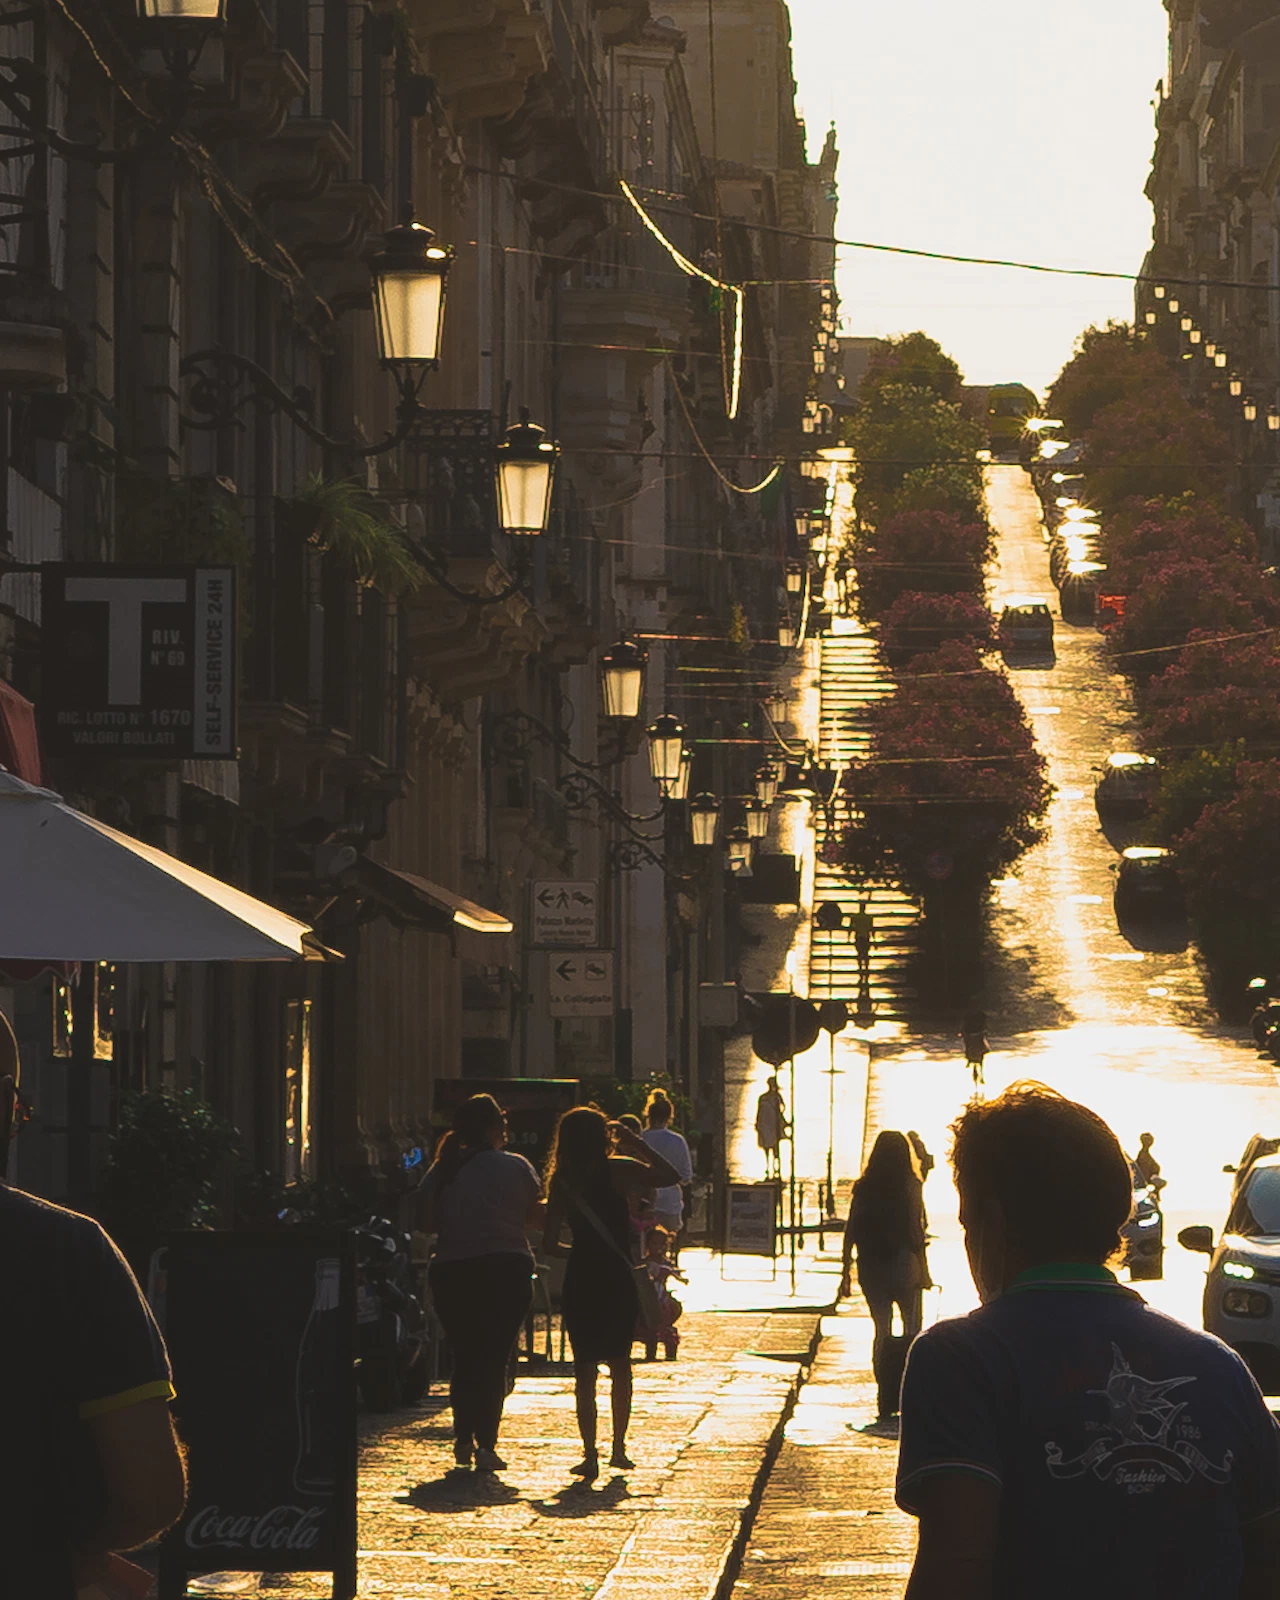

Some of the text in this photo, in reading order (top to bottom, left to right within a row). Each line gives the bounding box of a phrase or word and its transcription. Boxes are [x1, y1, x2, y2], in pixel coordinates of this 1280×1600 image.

[64, 577, 187, 706] T
[151, 629, 185, 646] RIV.
[150, 650, 186, 667] N° 69
[205, 578, 224, 747] SELF-SERVICE 24H
[57, 712, 83, 726] RIC.
[86, 712, 126, 725] LOTTO
[150, 709, 193, 727] 1670
[72, 731, 177, 746] VALORI BOLLATI
[1176, 1424, 1202, 1440] 1986
[184, 1504, 327, 1550] Coca-Cola
